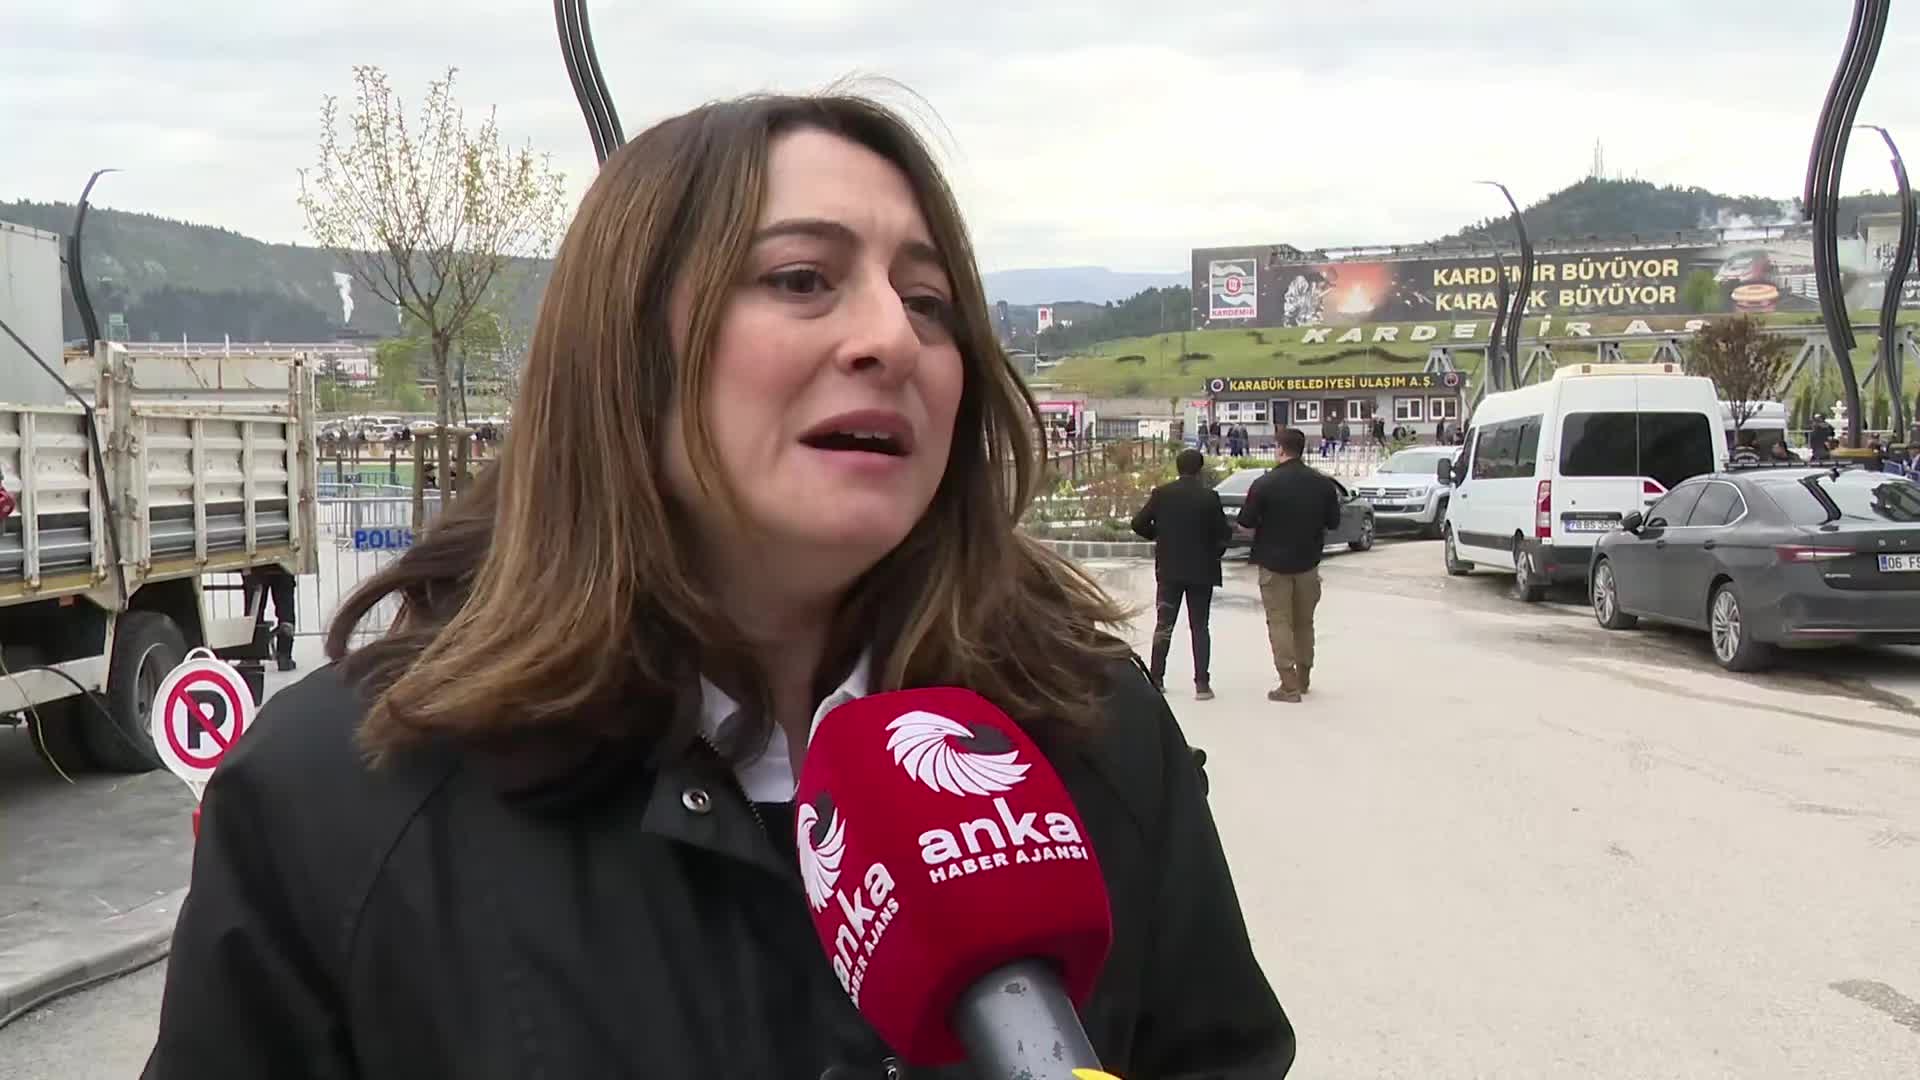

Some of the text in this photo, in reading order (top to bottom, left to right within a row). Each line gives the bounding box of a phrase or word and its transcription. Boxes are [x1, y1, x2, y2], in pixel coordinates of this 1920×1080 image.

[1561, 256, 1679, 281] BÜYÜYOR
[1435, 283, 1676, 311] KARAK BÜYÜYOR
[1230, 378, 1284, 391] KARABÜK
[1287, 376, 1356, 390] BELEDİYESİ
[1359, 375, 1406, 389] ULAŞIM
[1888, 556, 1902, 569] 06
[187, 690, 227, 749] P
[918, 797, 1083, 865] anka
[929, 852, 1009, 884] HABER
[833, 862, 896, 995] anka
